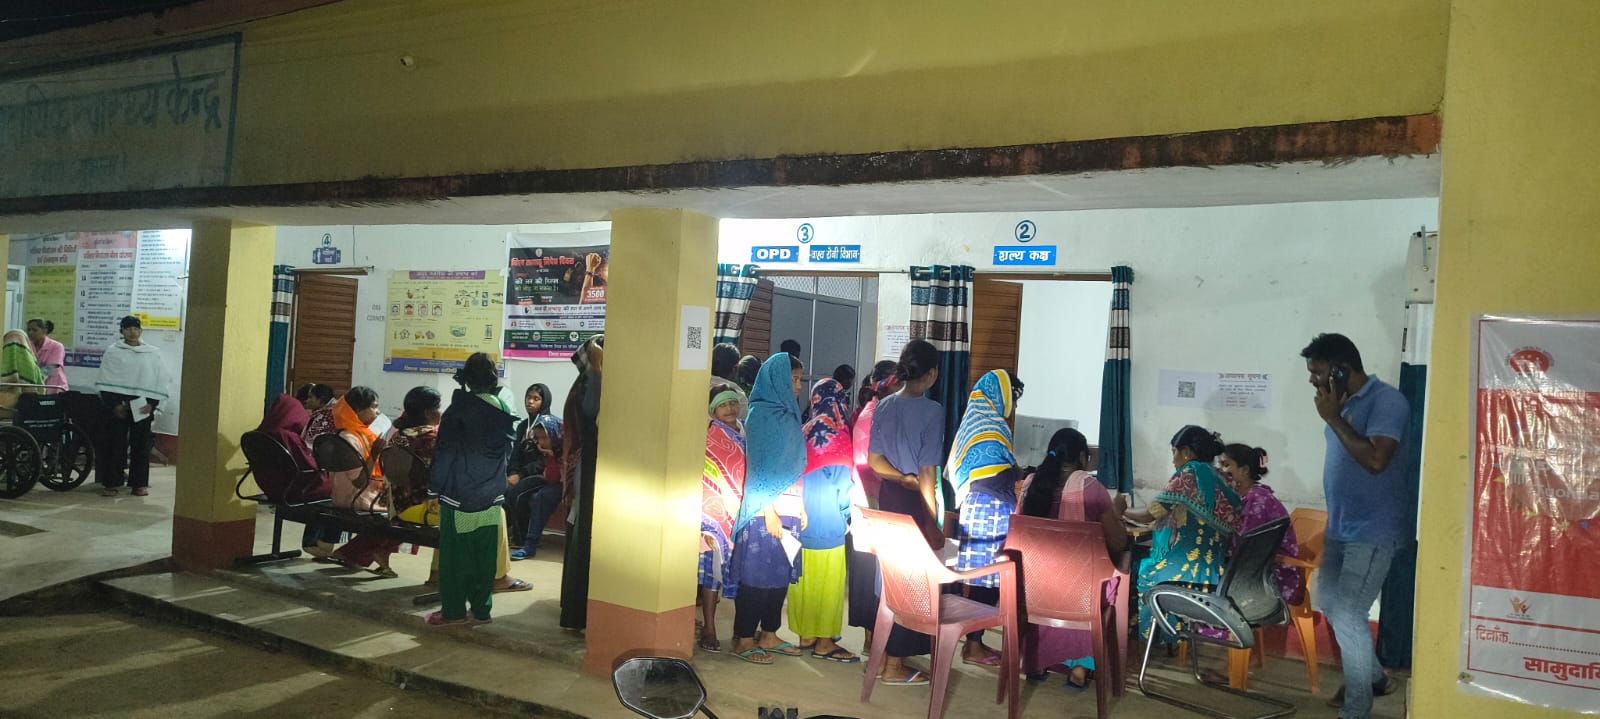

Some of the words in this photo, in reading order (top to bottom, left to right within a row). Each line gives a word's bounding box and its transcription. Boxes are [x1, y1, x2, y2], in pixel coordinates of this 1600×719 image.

[756, 248, 791, 260] OPD
[998, 250, 1026, 262] शल्य
[1028, 250, 1051, 262] कक्ष
